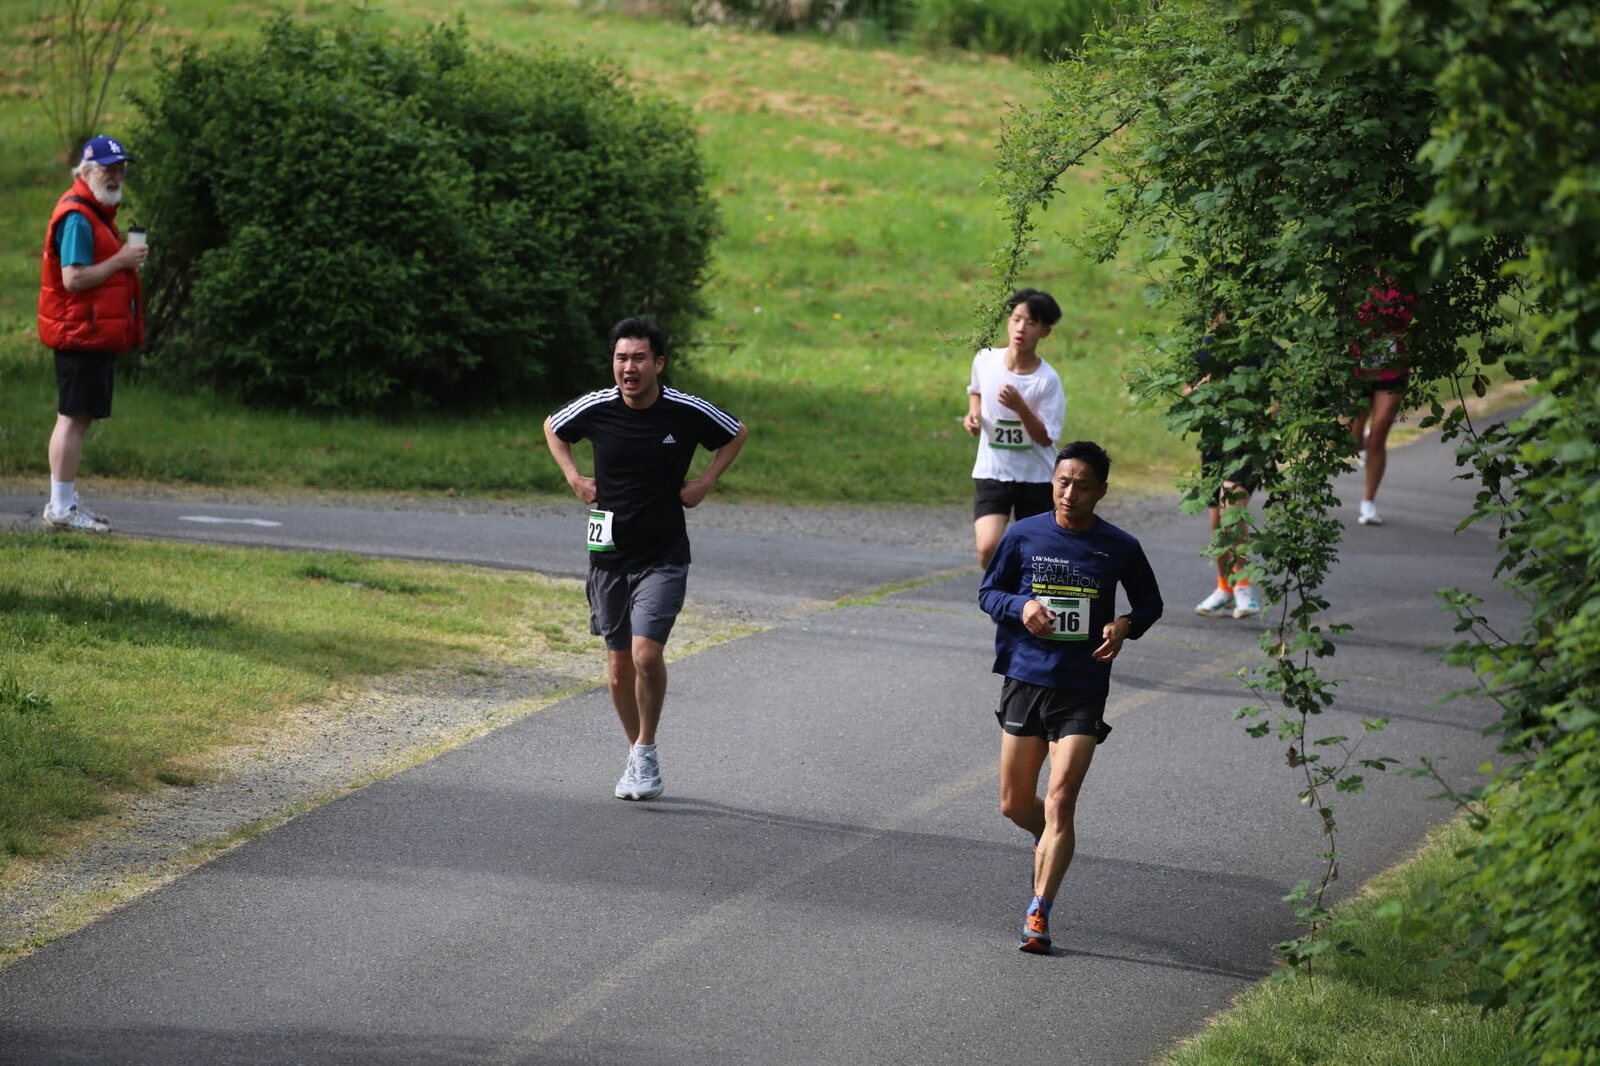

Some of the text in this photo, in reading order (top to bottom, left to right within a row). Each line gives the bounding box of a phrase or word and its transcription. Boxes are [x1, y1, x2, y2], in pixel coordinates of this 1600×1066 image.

[995, 428, 1024, 444] 213
[589, 522, 603, 543] 22
[1043, 557, 1069, 565] Medicine
[1031, 563, 1080, 576] SEATTLE
[1031, 573, 1100, 588] MARATHON
[1057, 590, 1087, 598] MARATHON
